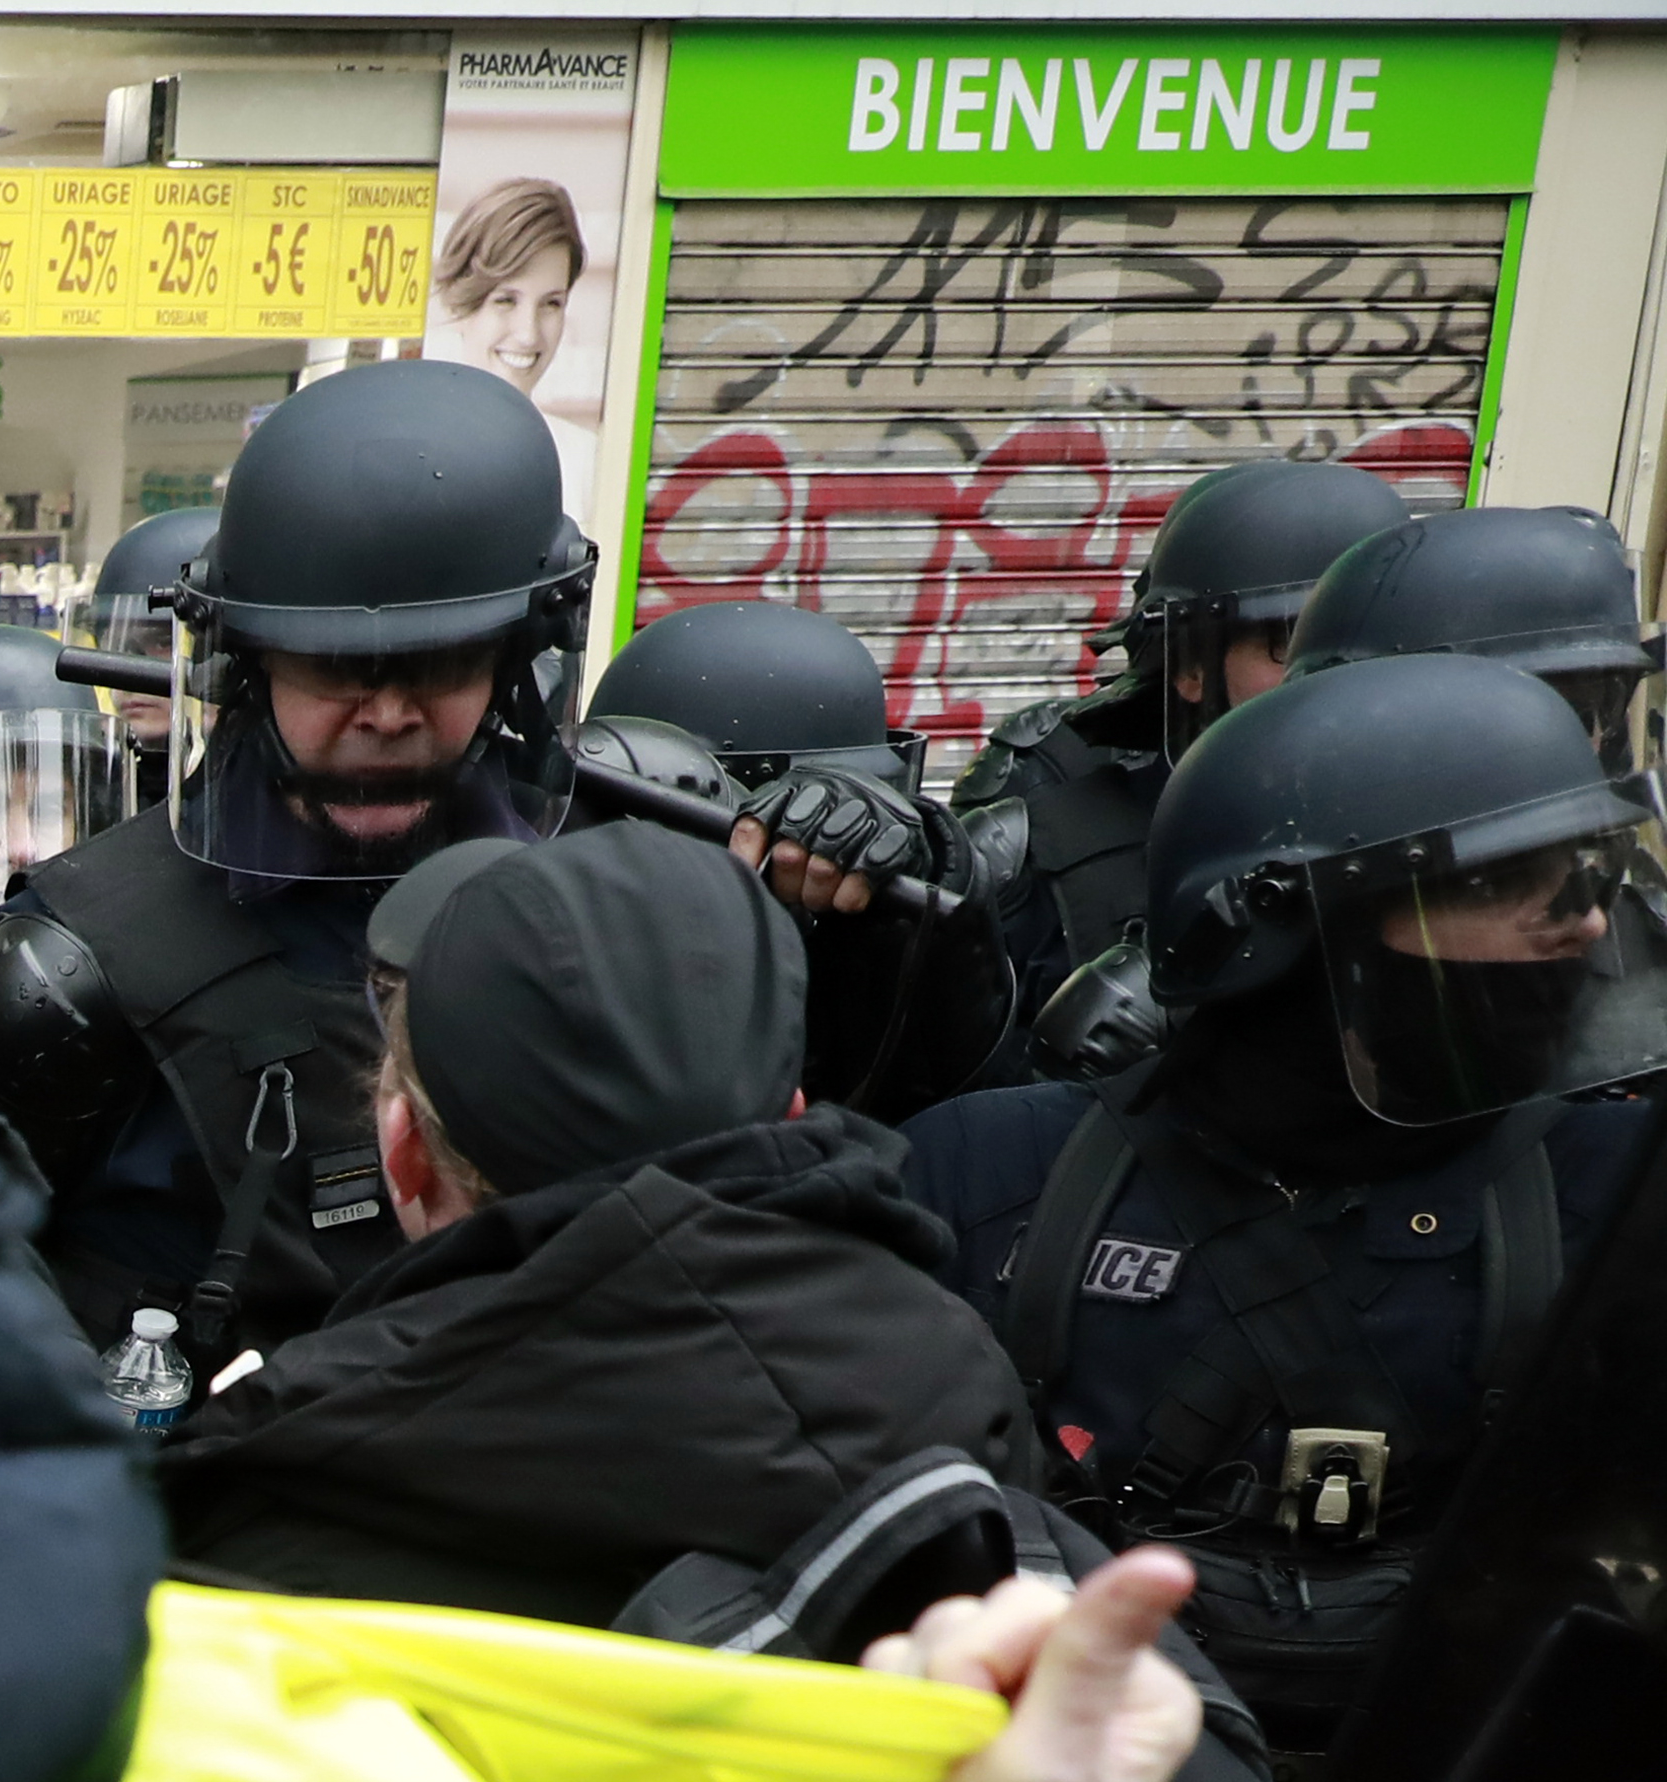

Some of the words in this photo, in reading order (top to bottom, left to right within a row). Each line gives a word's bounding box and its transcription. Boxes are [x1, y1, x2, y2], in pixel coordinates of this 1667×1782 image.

[848, 57, 1381, 152] BIENVENUE
[53, 182, 131, 205] URIAGE
[154, 183, 231, 206] URIAGE
[272, 186, 307, 207] STC
[347, 186, 430, 208] SKINADVANCE
[48, 219, 117, 296] -25%
[149, 220, 218, 297] -25%
